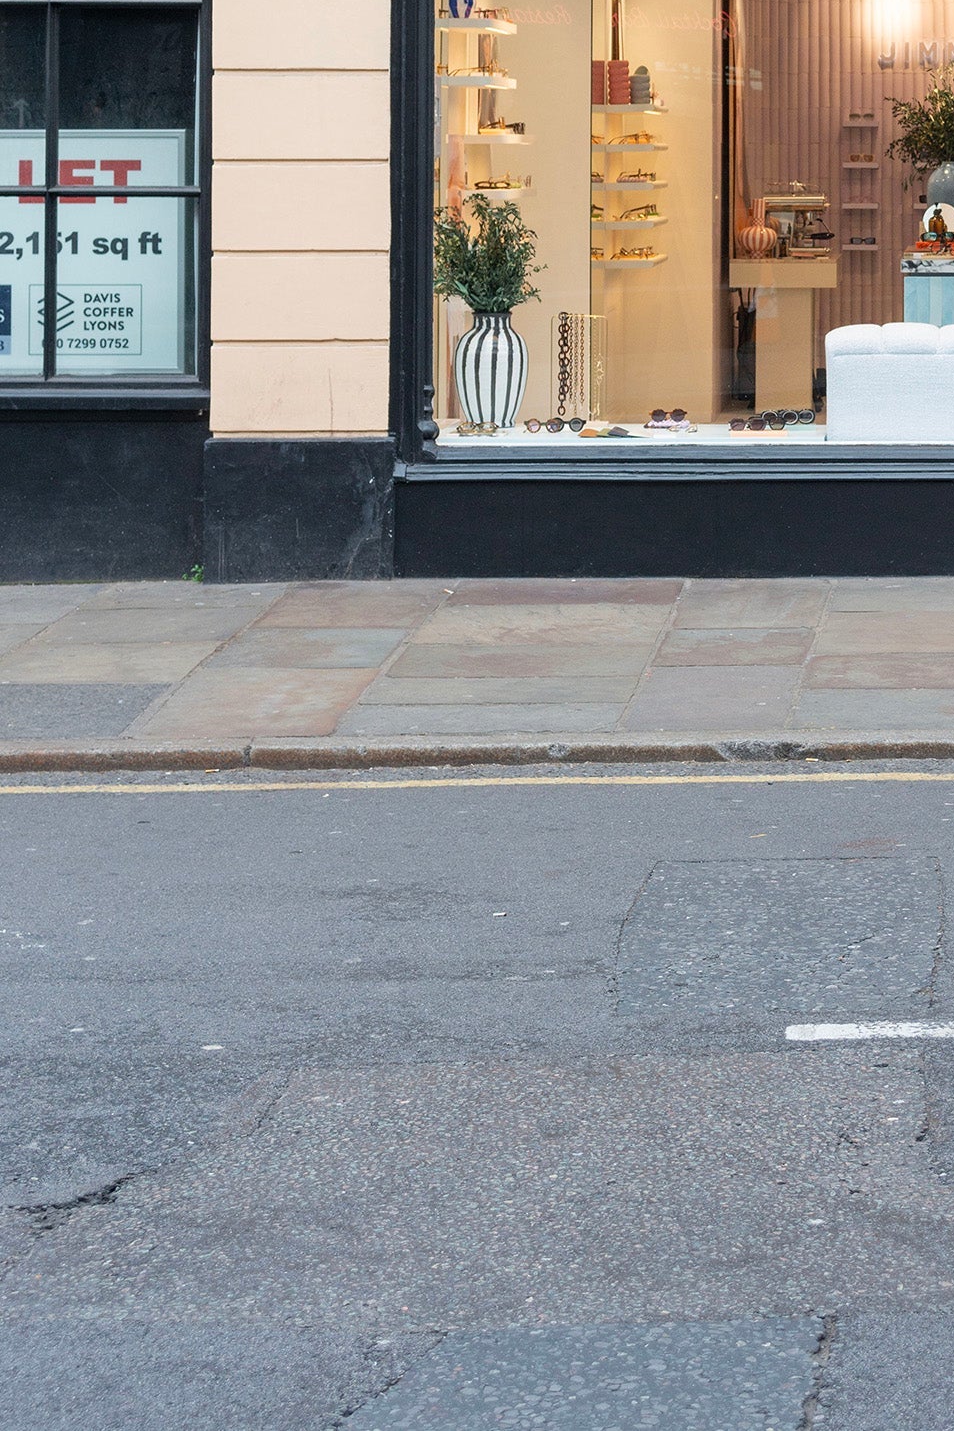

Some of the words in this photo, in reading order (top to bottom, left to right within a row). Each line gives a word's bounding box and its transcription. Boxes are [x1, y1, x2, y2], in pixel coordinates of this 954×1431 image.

[18, 159, 142, 204] LET
[92, 236, 129, 261] sq
[138, 231, 163, 255] ft
[83, 293, 121, 304] DAVIS
[83, 307, 134, 318] COFFER
[83, 320, 125, 331] LYONS
[67, 338, 97, 349] 7299
[99, 338, 129, 349] 0752
